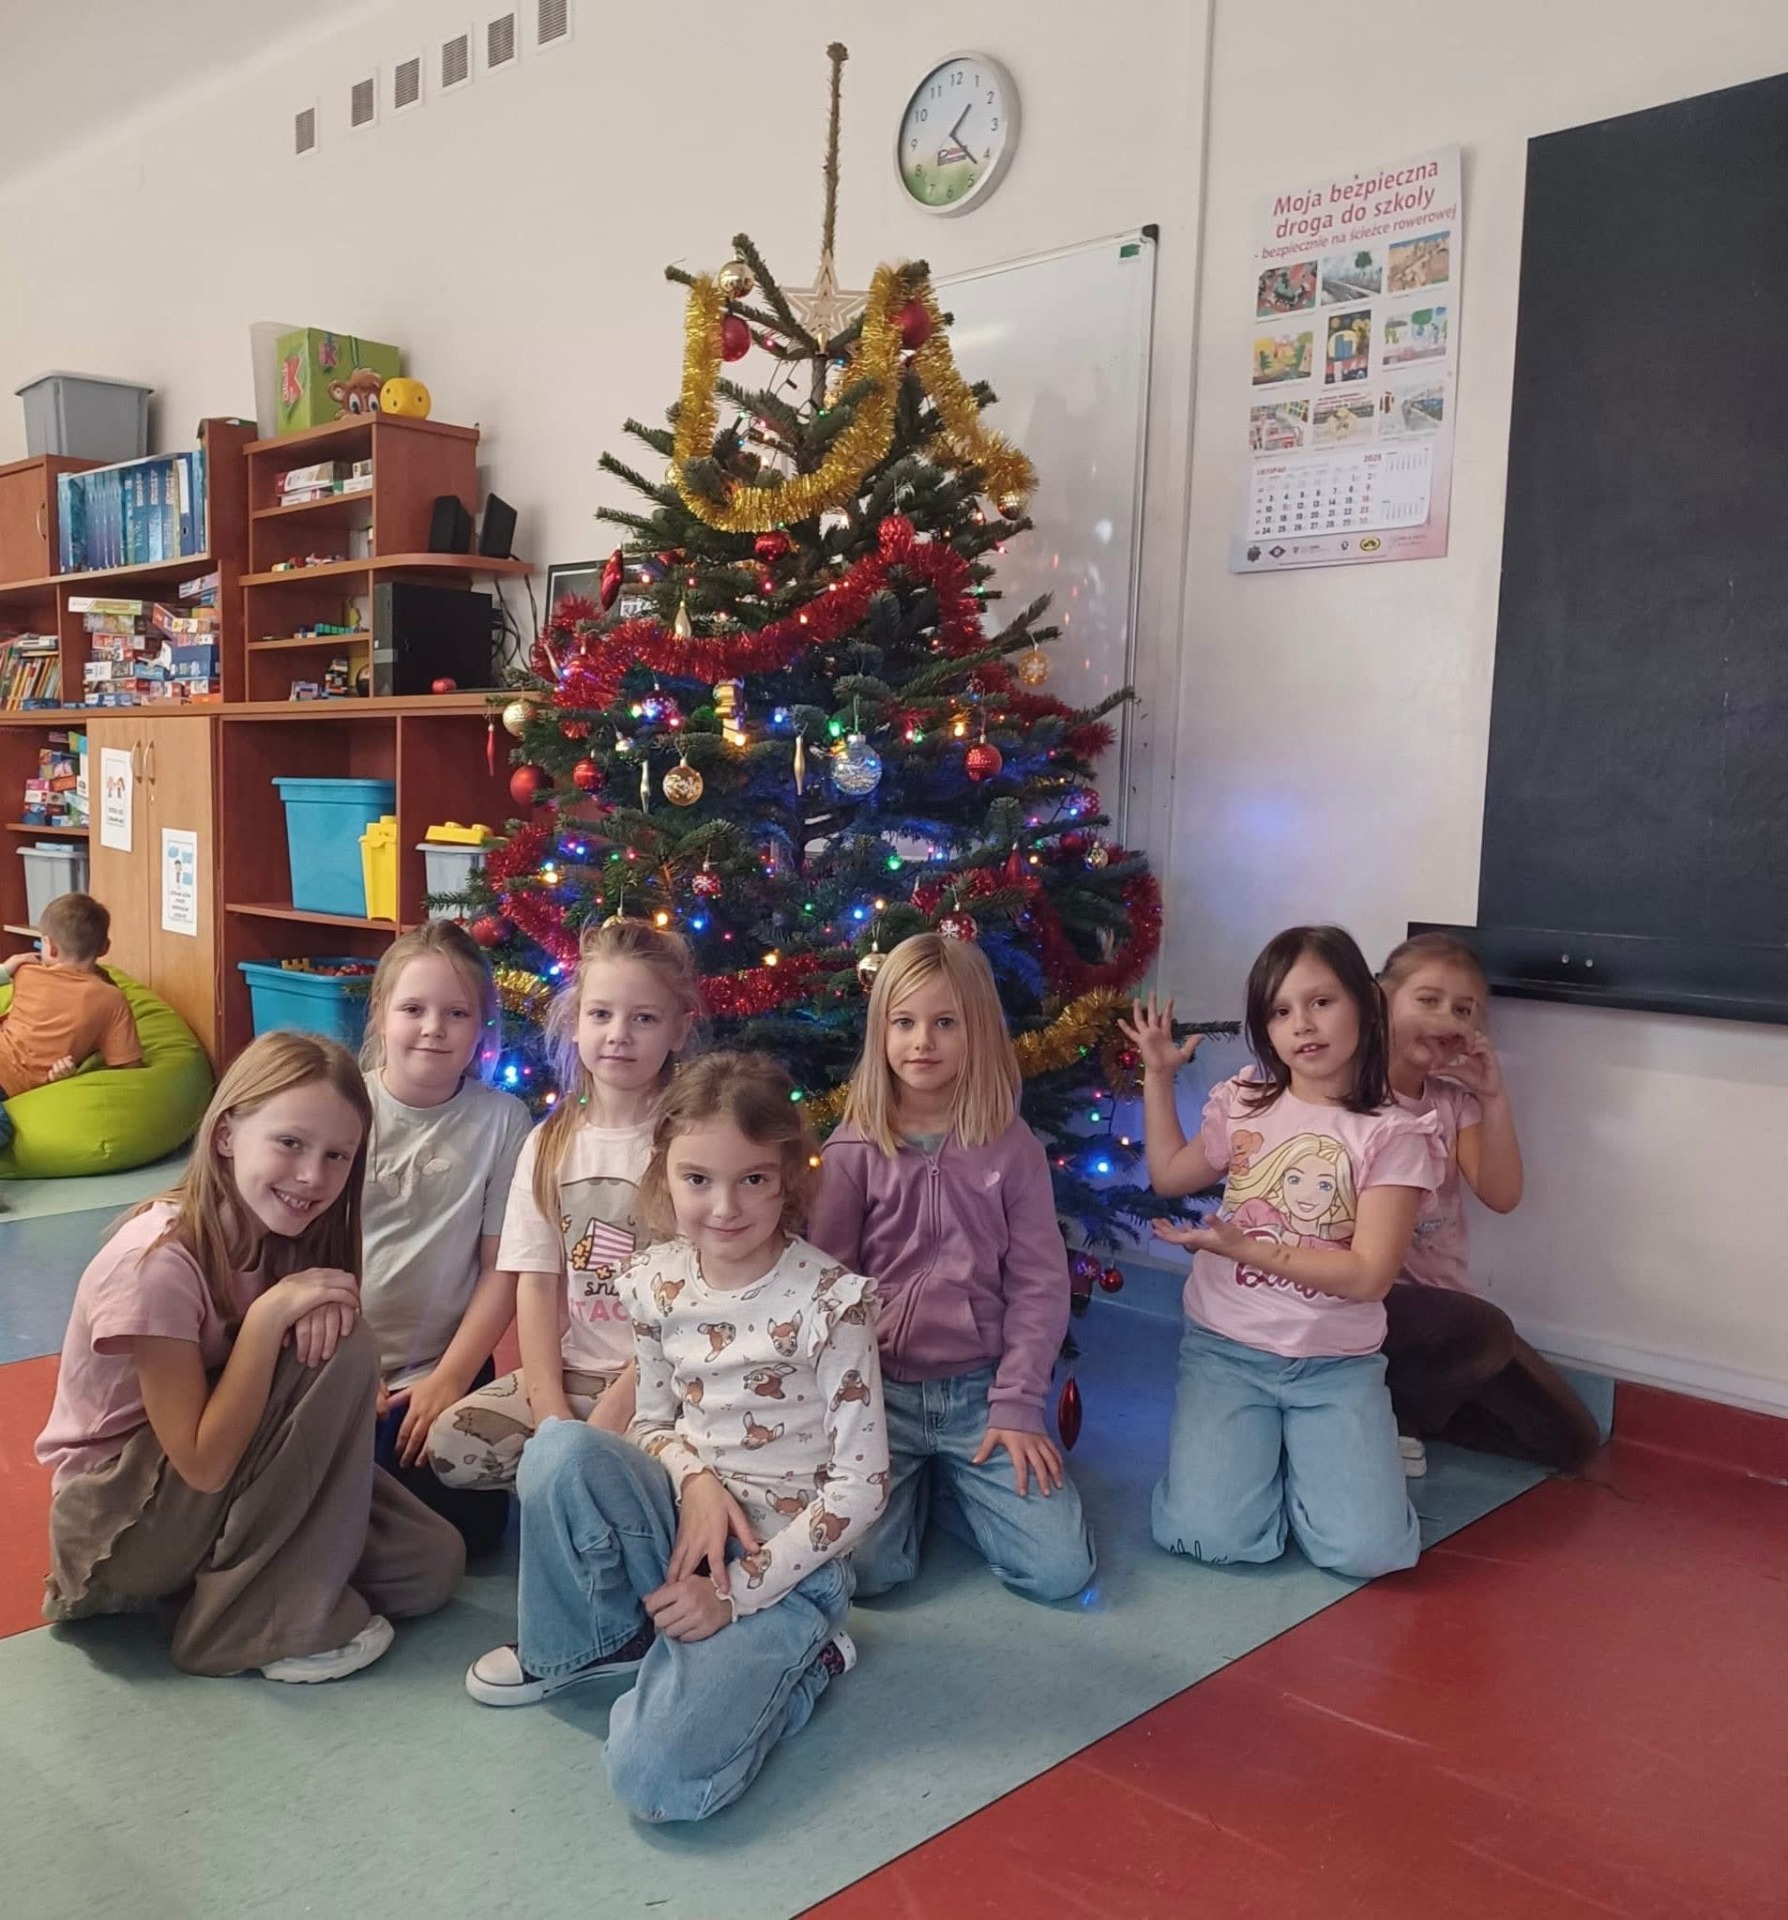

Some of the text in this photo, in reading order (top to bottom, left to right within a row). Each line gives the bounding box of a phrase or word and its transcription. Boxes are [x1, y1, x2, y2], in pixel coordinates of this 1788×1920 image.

[950, 72, 963, 86] 12
[975, 75, 980, 88] 1
[930, 85, 942, 99] 11
[986, 91, 995, 104] 2
[915, 108, 928, 123] 10
[991, 117, 999, 131] 3
[911, 138, 918, 151] 9
[982, 147, 991, 158] 4
[915, 164, 922, 178] 8
[967, 173, 976, 188] 5
[928, 184, 936, 197] 7
[946, 184, 954, 198] 6
[1273, 161, 1438, 216] Moja bezpieczna
[1276, 214, 1333, 239] droga
[1341, 203, 1367, 224] do
[1331, 233, 1346, 245] na
[1393, 203, 1457, 231] rowerowej
[570, 1298, 629, 1322] TAC
